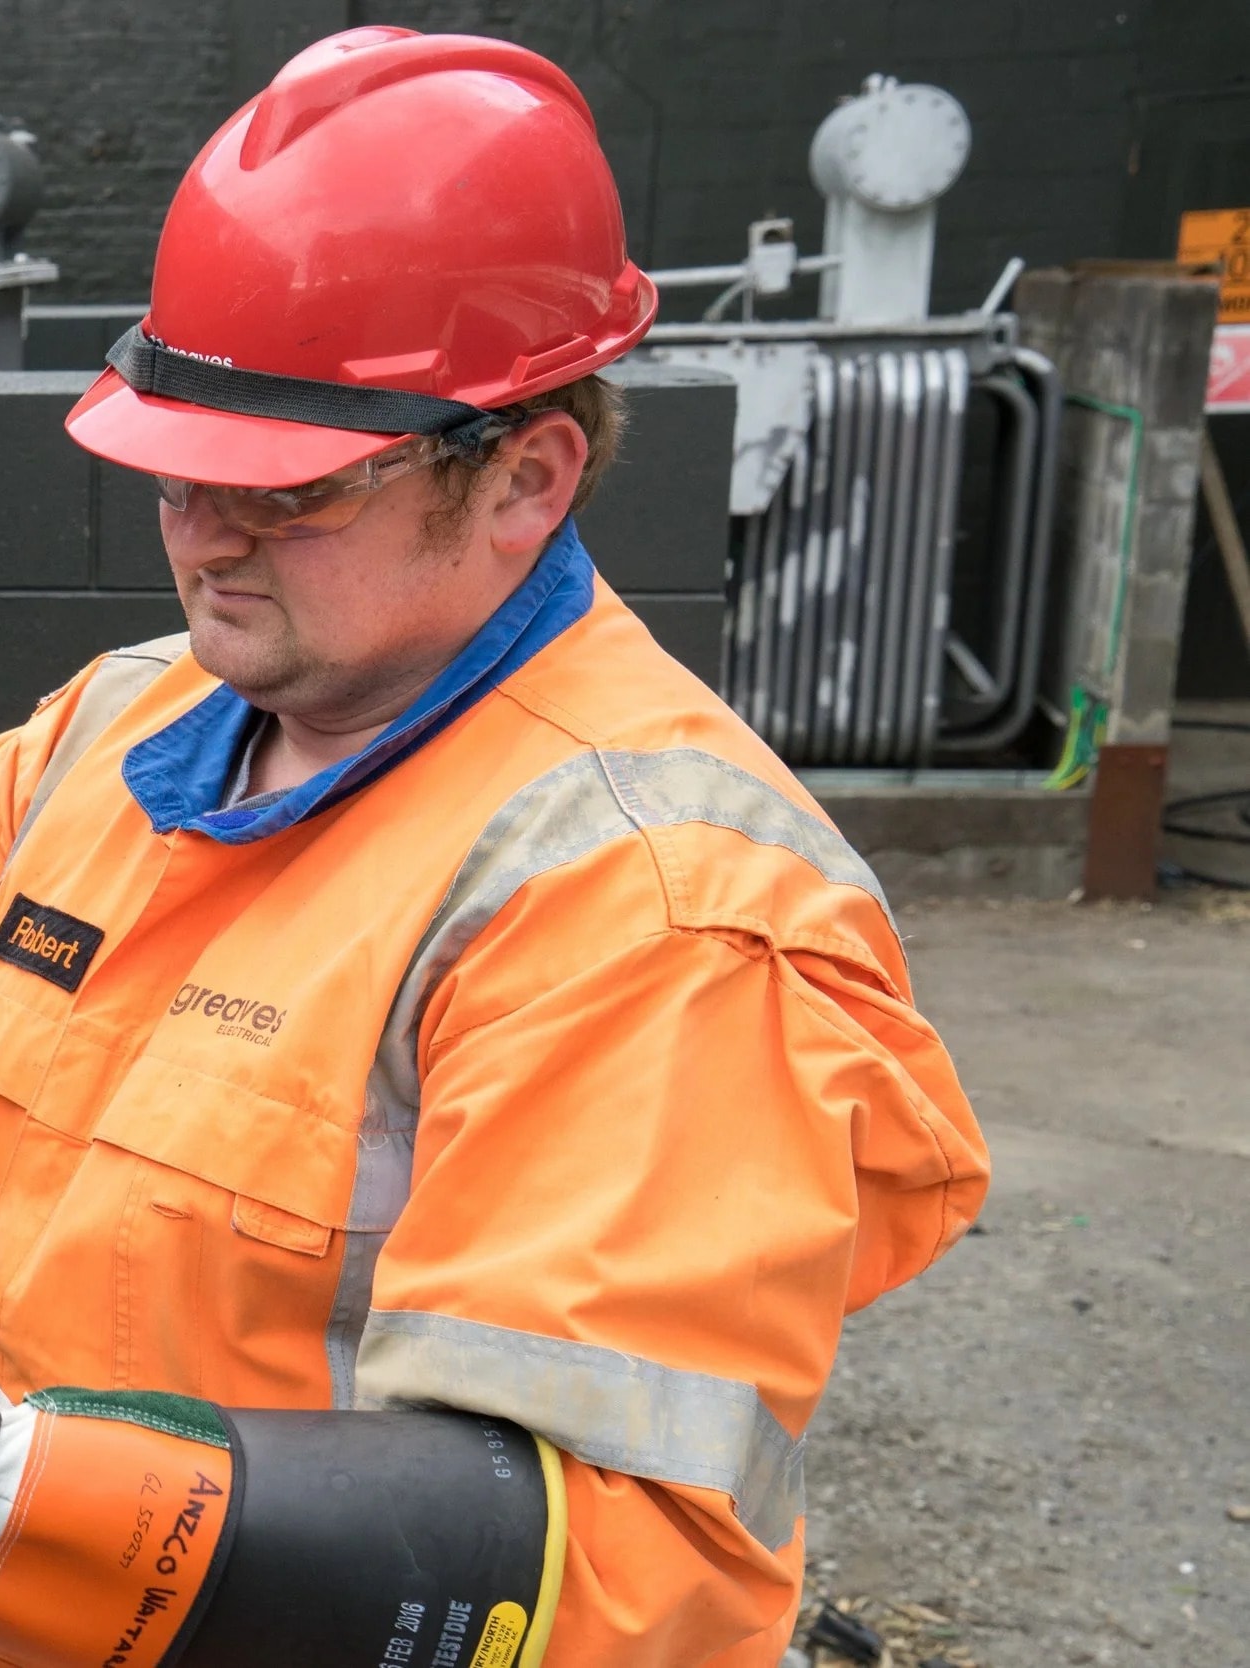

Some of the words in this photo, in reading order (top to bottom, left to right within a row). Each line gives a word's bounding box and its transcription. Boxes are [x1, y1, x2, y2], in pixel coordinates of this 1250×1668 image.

[7, 915, 79, 970] Robert
[169, 983, 287, 1034] greaves
[216, 1023, 273, 1047] ELECTRICAL
[156, 1471, 223, 1575] ANZCO
[394, 1602, 426, 1633] 2016
[443, 1600, 473, 1634] DUE
[384, 1637, 415, 1662] FEB
[473, 1615, 501, 1668] RY/NORTH
